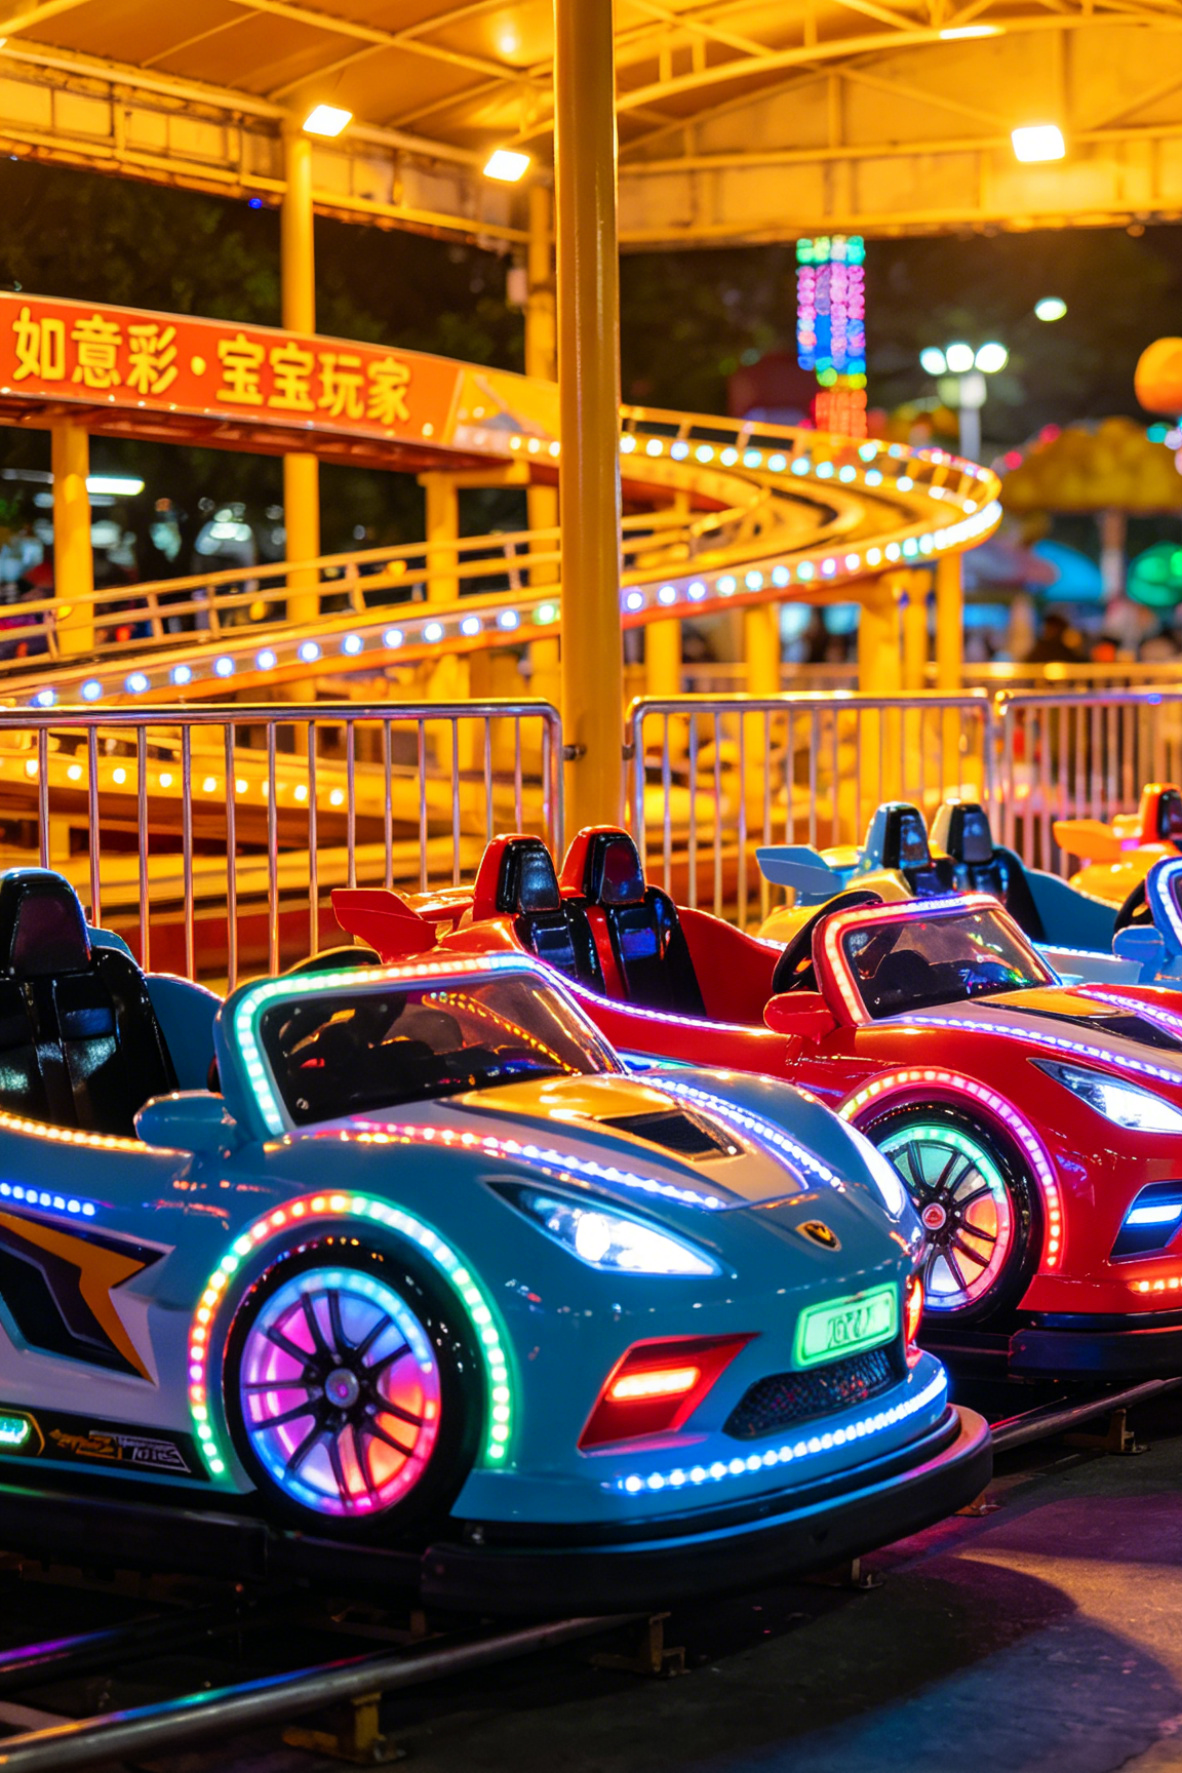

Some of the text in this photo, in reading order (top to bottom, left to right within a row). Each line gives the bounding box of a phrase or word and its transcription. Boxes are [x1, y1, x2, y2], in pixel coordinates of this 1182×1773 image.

[12, 306, 412, 425] 如意彩·宝宝玩家
